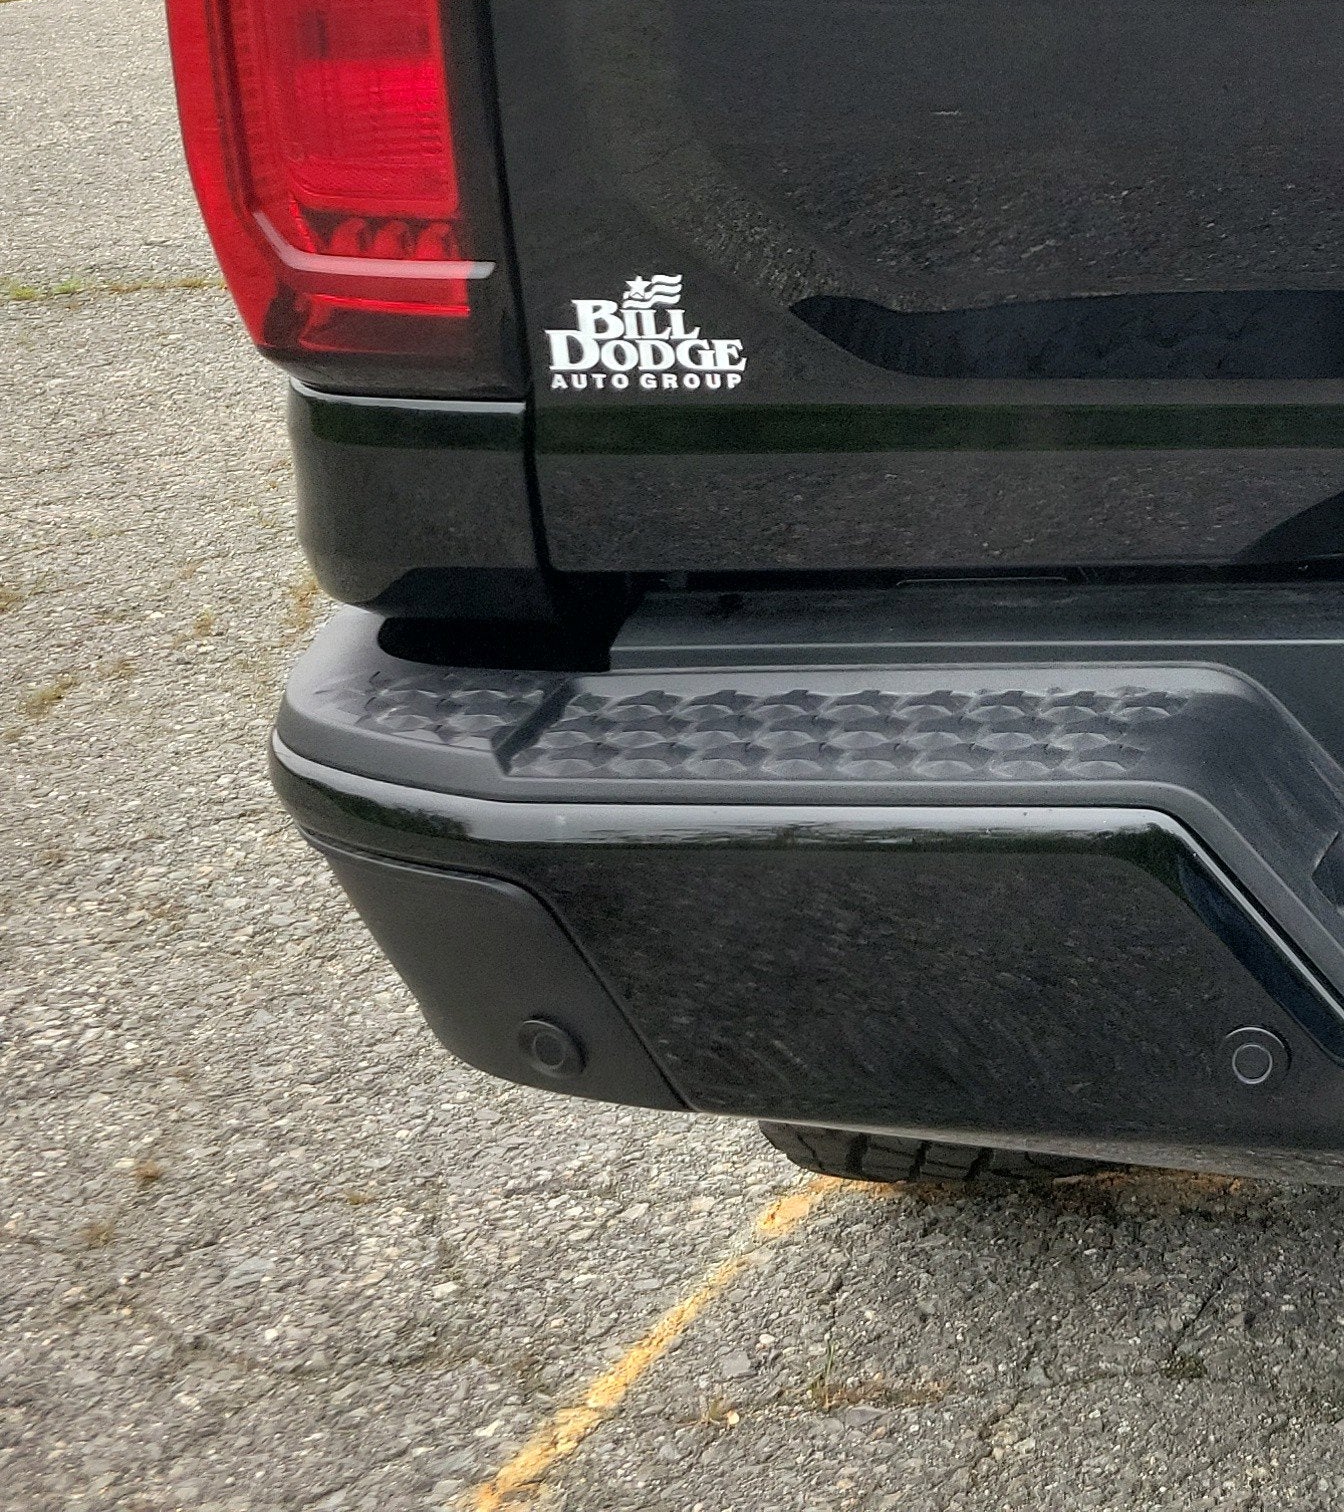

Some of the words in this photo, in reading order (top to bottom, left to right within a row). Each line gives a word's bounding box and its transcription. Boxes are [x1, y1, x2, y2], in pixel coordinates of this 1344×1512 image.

[571, 299, 701, 340] BILL
[544, 329, 748, 372] DODGE
[551, 373, 629, 389] AUTO
[639, 373, 742, 389] GROUP
